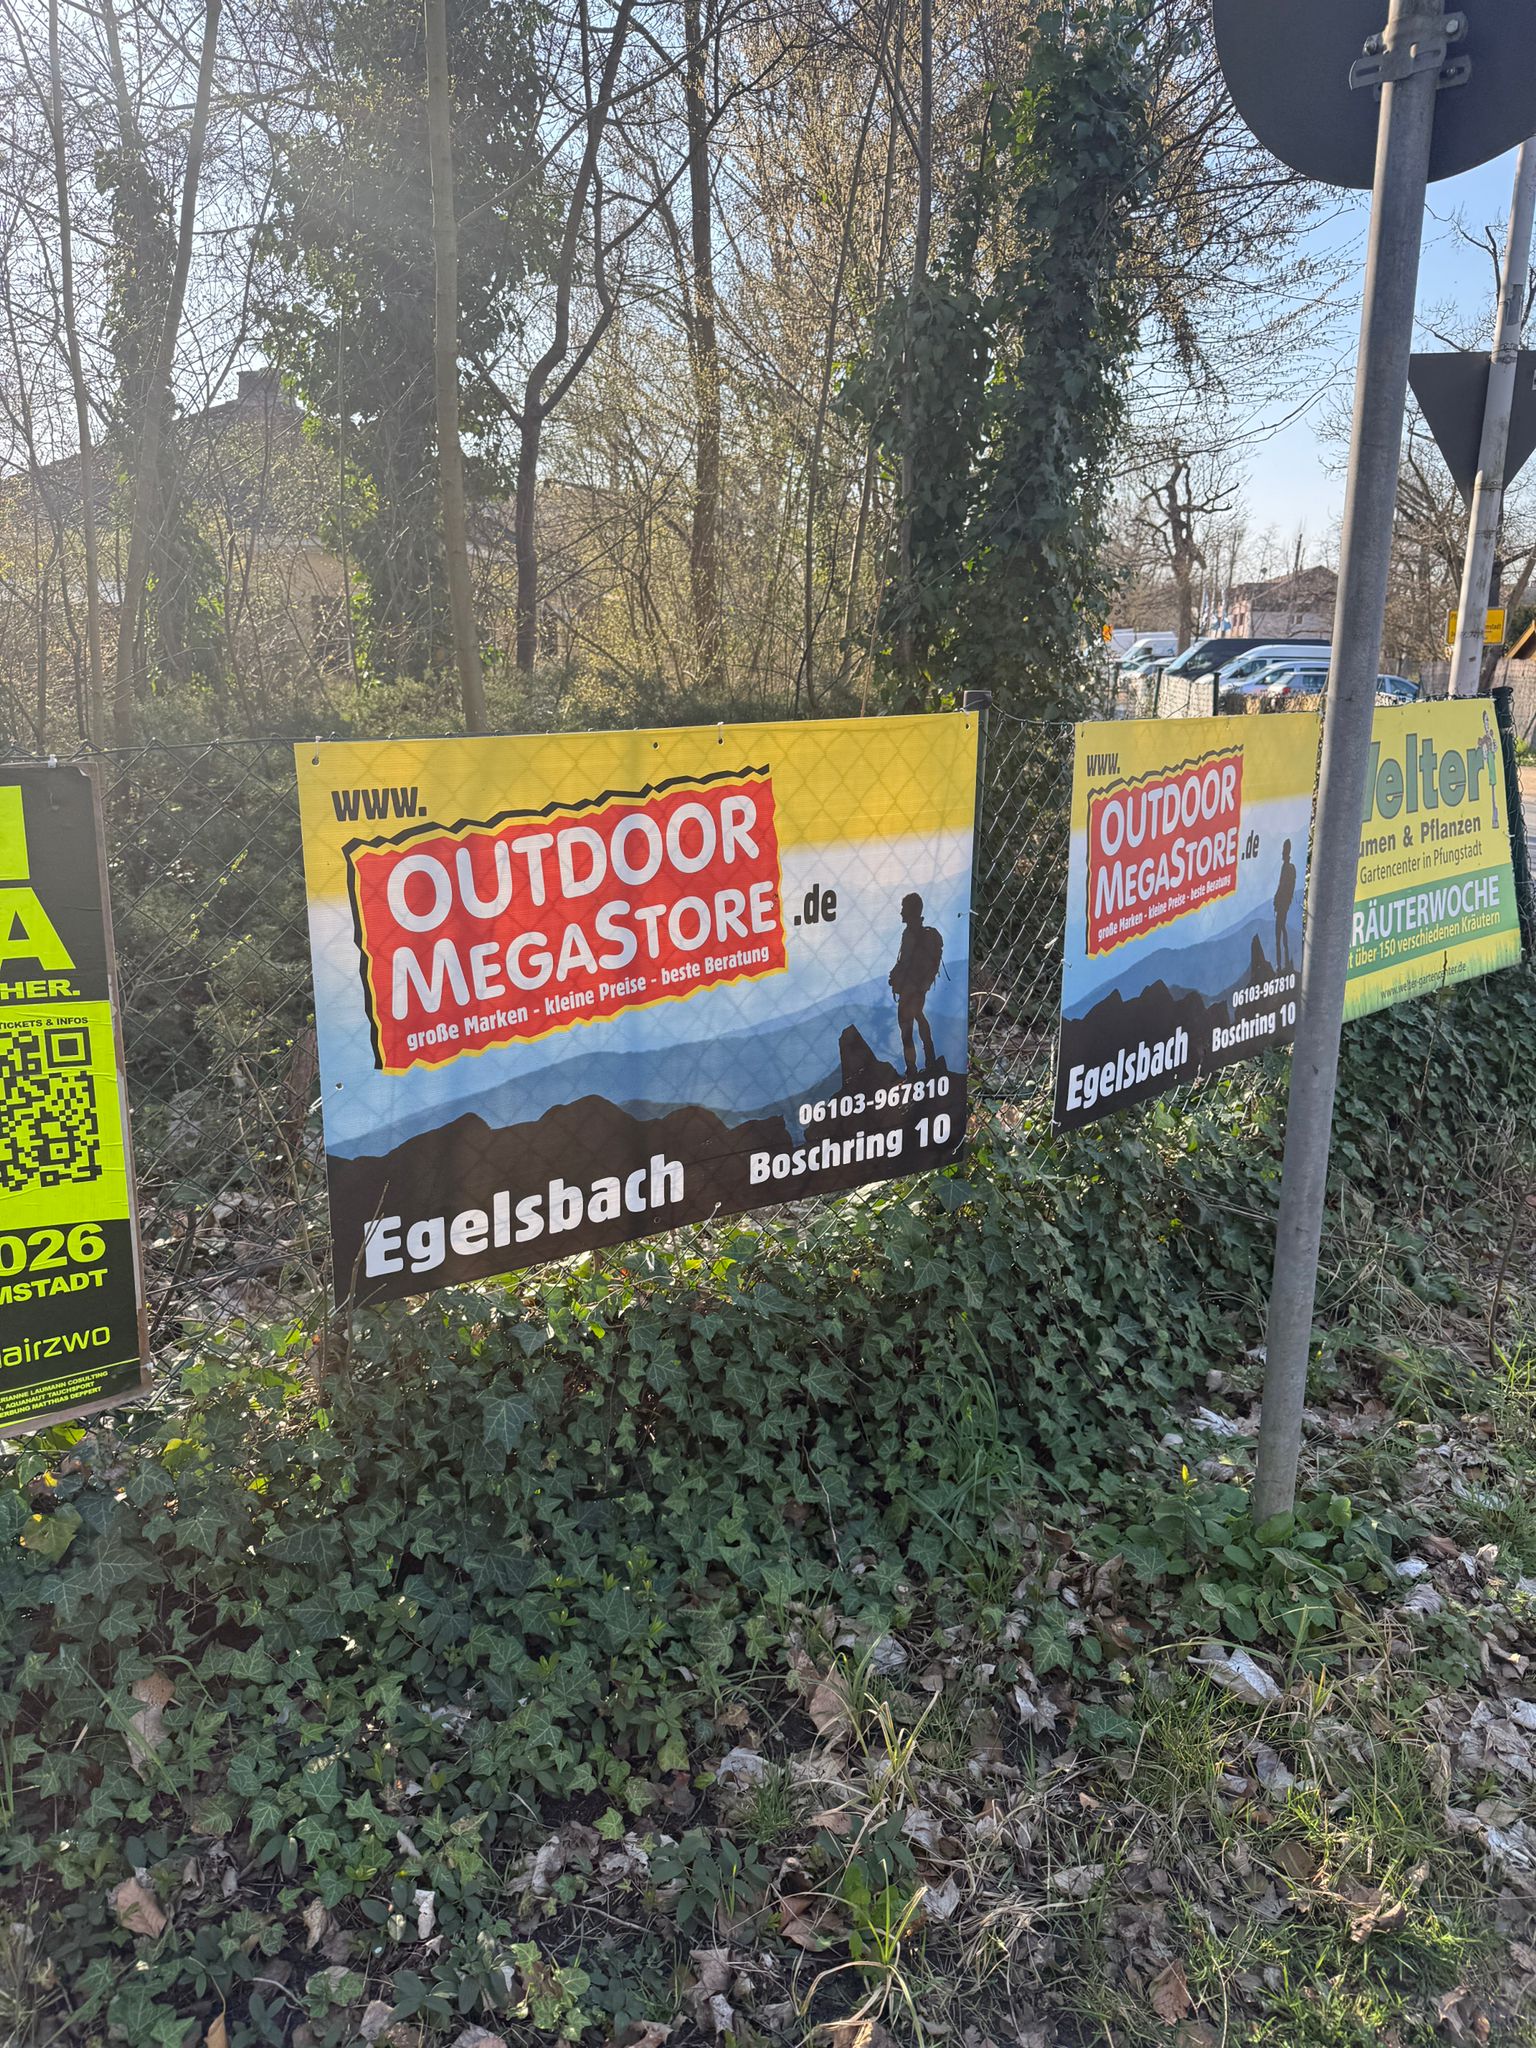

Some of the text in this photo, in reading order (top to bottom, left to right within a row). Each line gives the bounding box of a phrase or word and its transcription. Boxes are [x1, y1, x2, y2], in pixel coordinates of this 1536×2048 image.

[1087, 753, 1120, 776] www.
[331, 787, 427, 822] www.
[1101, 765, 1236, 856] OUTDOOR
[1403, 825, 1413, 848] &
[1421, 816, 1481, 844] Pflanzen
[387, 795, 759, 932] OUTDOOR
[1095, 827, 1259, 919] MEGASTORE .de
[1360, 840, 1483, 884] Gartencenter in Pfungstadt
[1098, 921, 1118, 942] große
[1120, 911, 1142, 931] Marken
[1149, 901, 1167, 919] kleine
[1168, 893, 1186, 912] Preise
[1190, 884, 1206, 900] beste
[1206, 874, 1231, 893] Beratung
[1350, 875, 1500, 948] RÄUTERWOCHE
[392, 881, 837, 1020] MEGASTORE .de
[1355, 945, 1377, 968] über
[1379, 938, 1396, 959] 150
[1398, 923, 1460, 953] verschiedenen
[1462, 911, 1501, 934] Kräutern
[0, 979, 80, 1000] HER.
[407, 1024, 459, 1052] große
[464, 1005, 528, 1037] Marken
[545, 988, 594, 1015] kleine
[599, 976, 646, 1001] Preise
[661, 962, 701, 985] beste
[705, 946, 770, 974] Beratung
[1233, 973, 1296, 1008] 06103-967810
[46, 1018, 53, 1026] &
[57, 1016, 88, 1026] INFOS
[1212, 1002, 1296, 1052] Boschring 10
[1066, 1026, 1189, 1112] Egelsbach
[799, 1076, 950, 1125] 06103-967810
[749, 1113, 951, 1185] Boschring 10
[364, 1153, 685, 1278] Egelsbach
[0, 1326, 111, 1368] airzwo
[0, 1371, 109, 1404] RIANNE LAUMANN COSULTING
[5, 1381, 95, 1410] AQUANAUT TAUCHSPORT
[32, 1396, 69, 1410] MATTHIAS
[70, 1386, 102, 1400] DEPPERT
